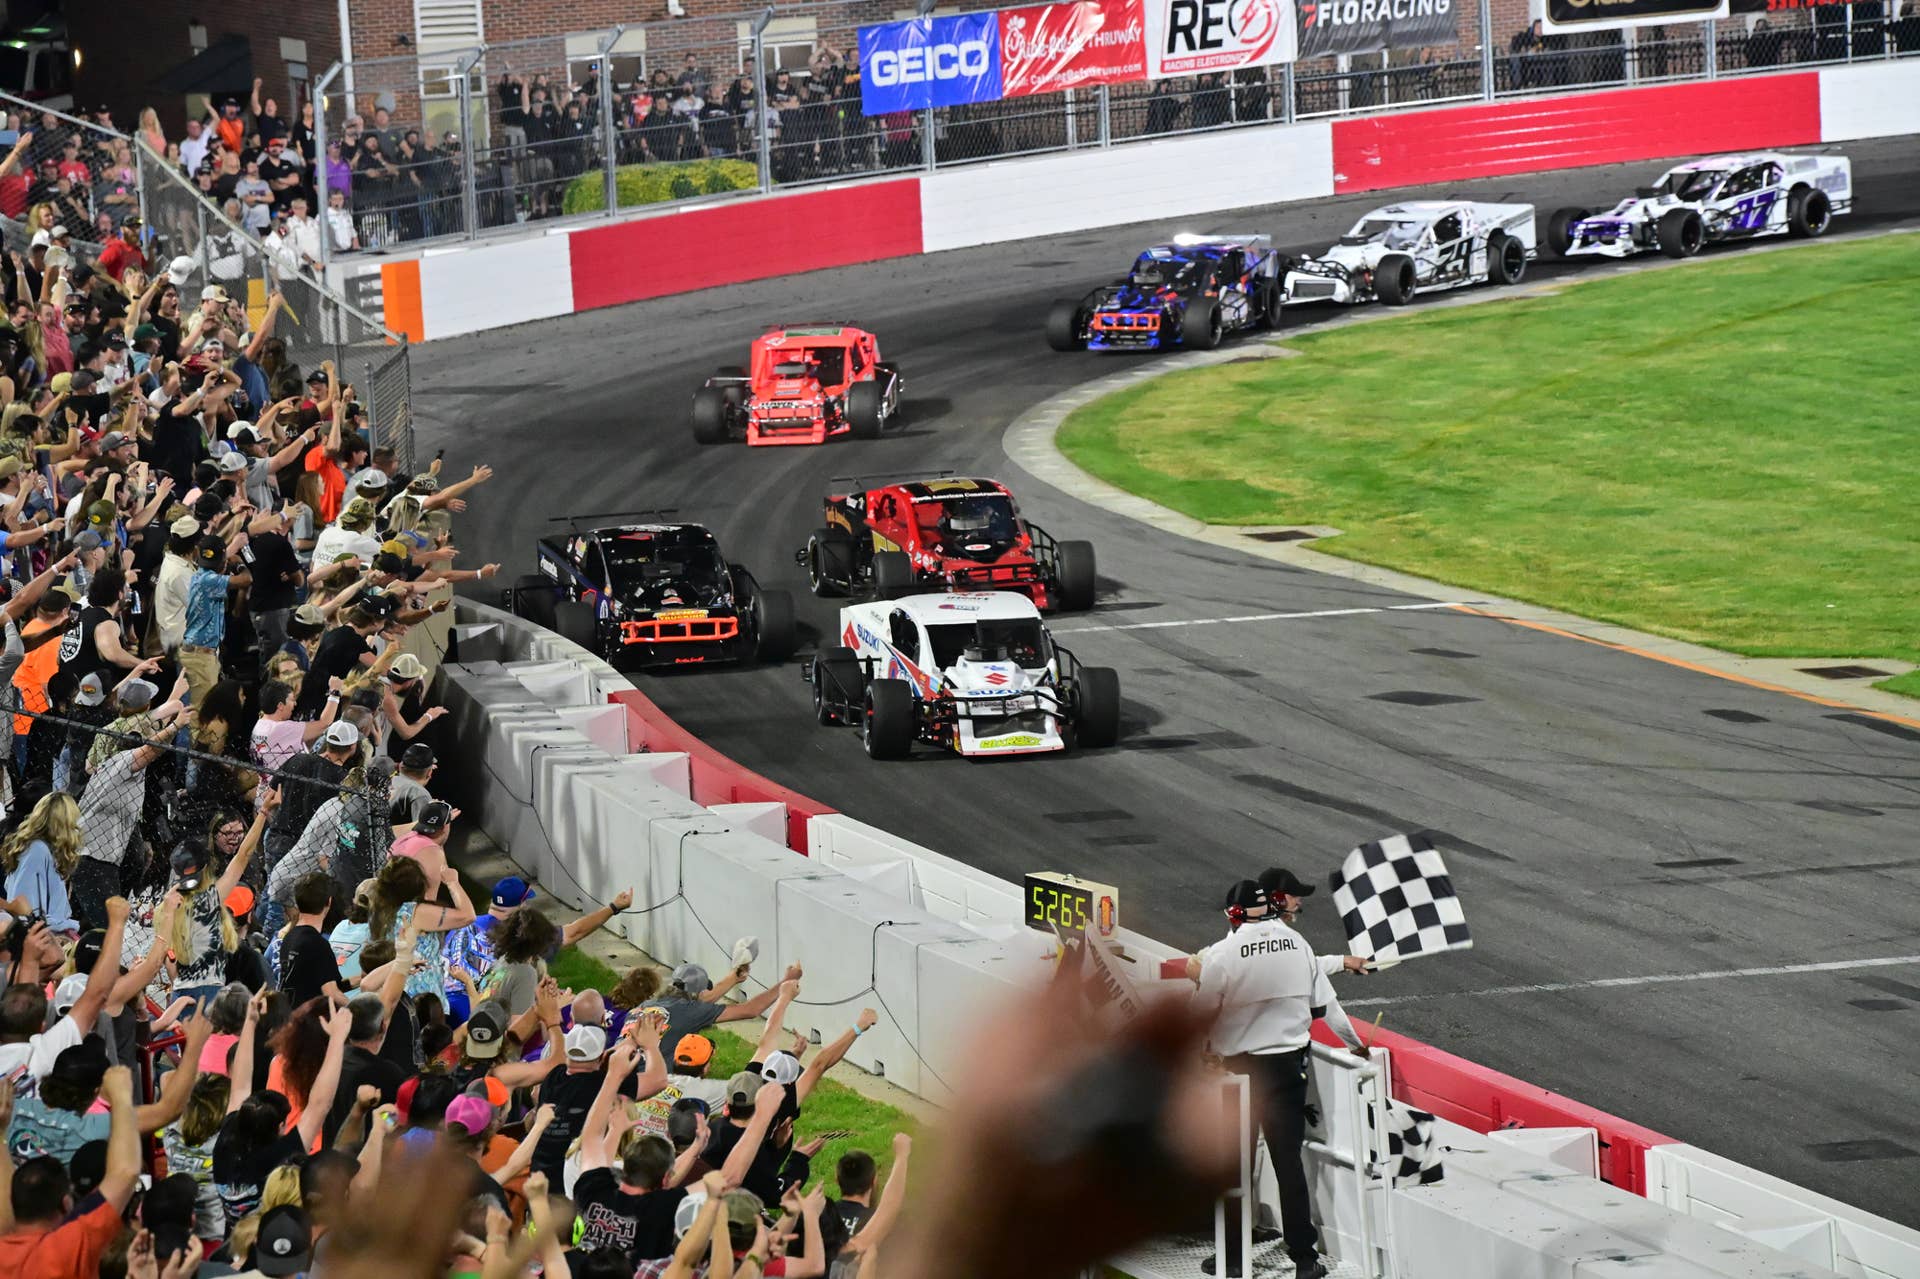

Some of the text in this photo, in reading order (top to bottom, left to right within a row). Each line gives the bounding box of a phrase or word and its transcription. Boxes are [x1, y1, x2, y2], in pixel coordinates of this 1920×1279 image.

[1088, 26, 1142, 49] THRUWAY
[870, 40, 990, 87] GEICO
[857, 623, 880, 651] SUZUKI
[1033, 886, 1087, 930] 5265
[1240, 938, 1298, 958] OFFICIAL
